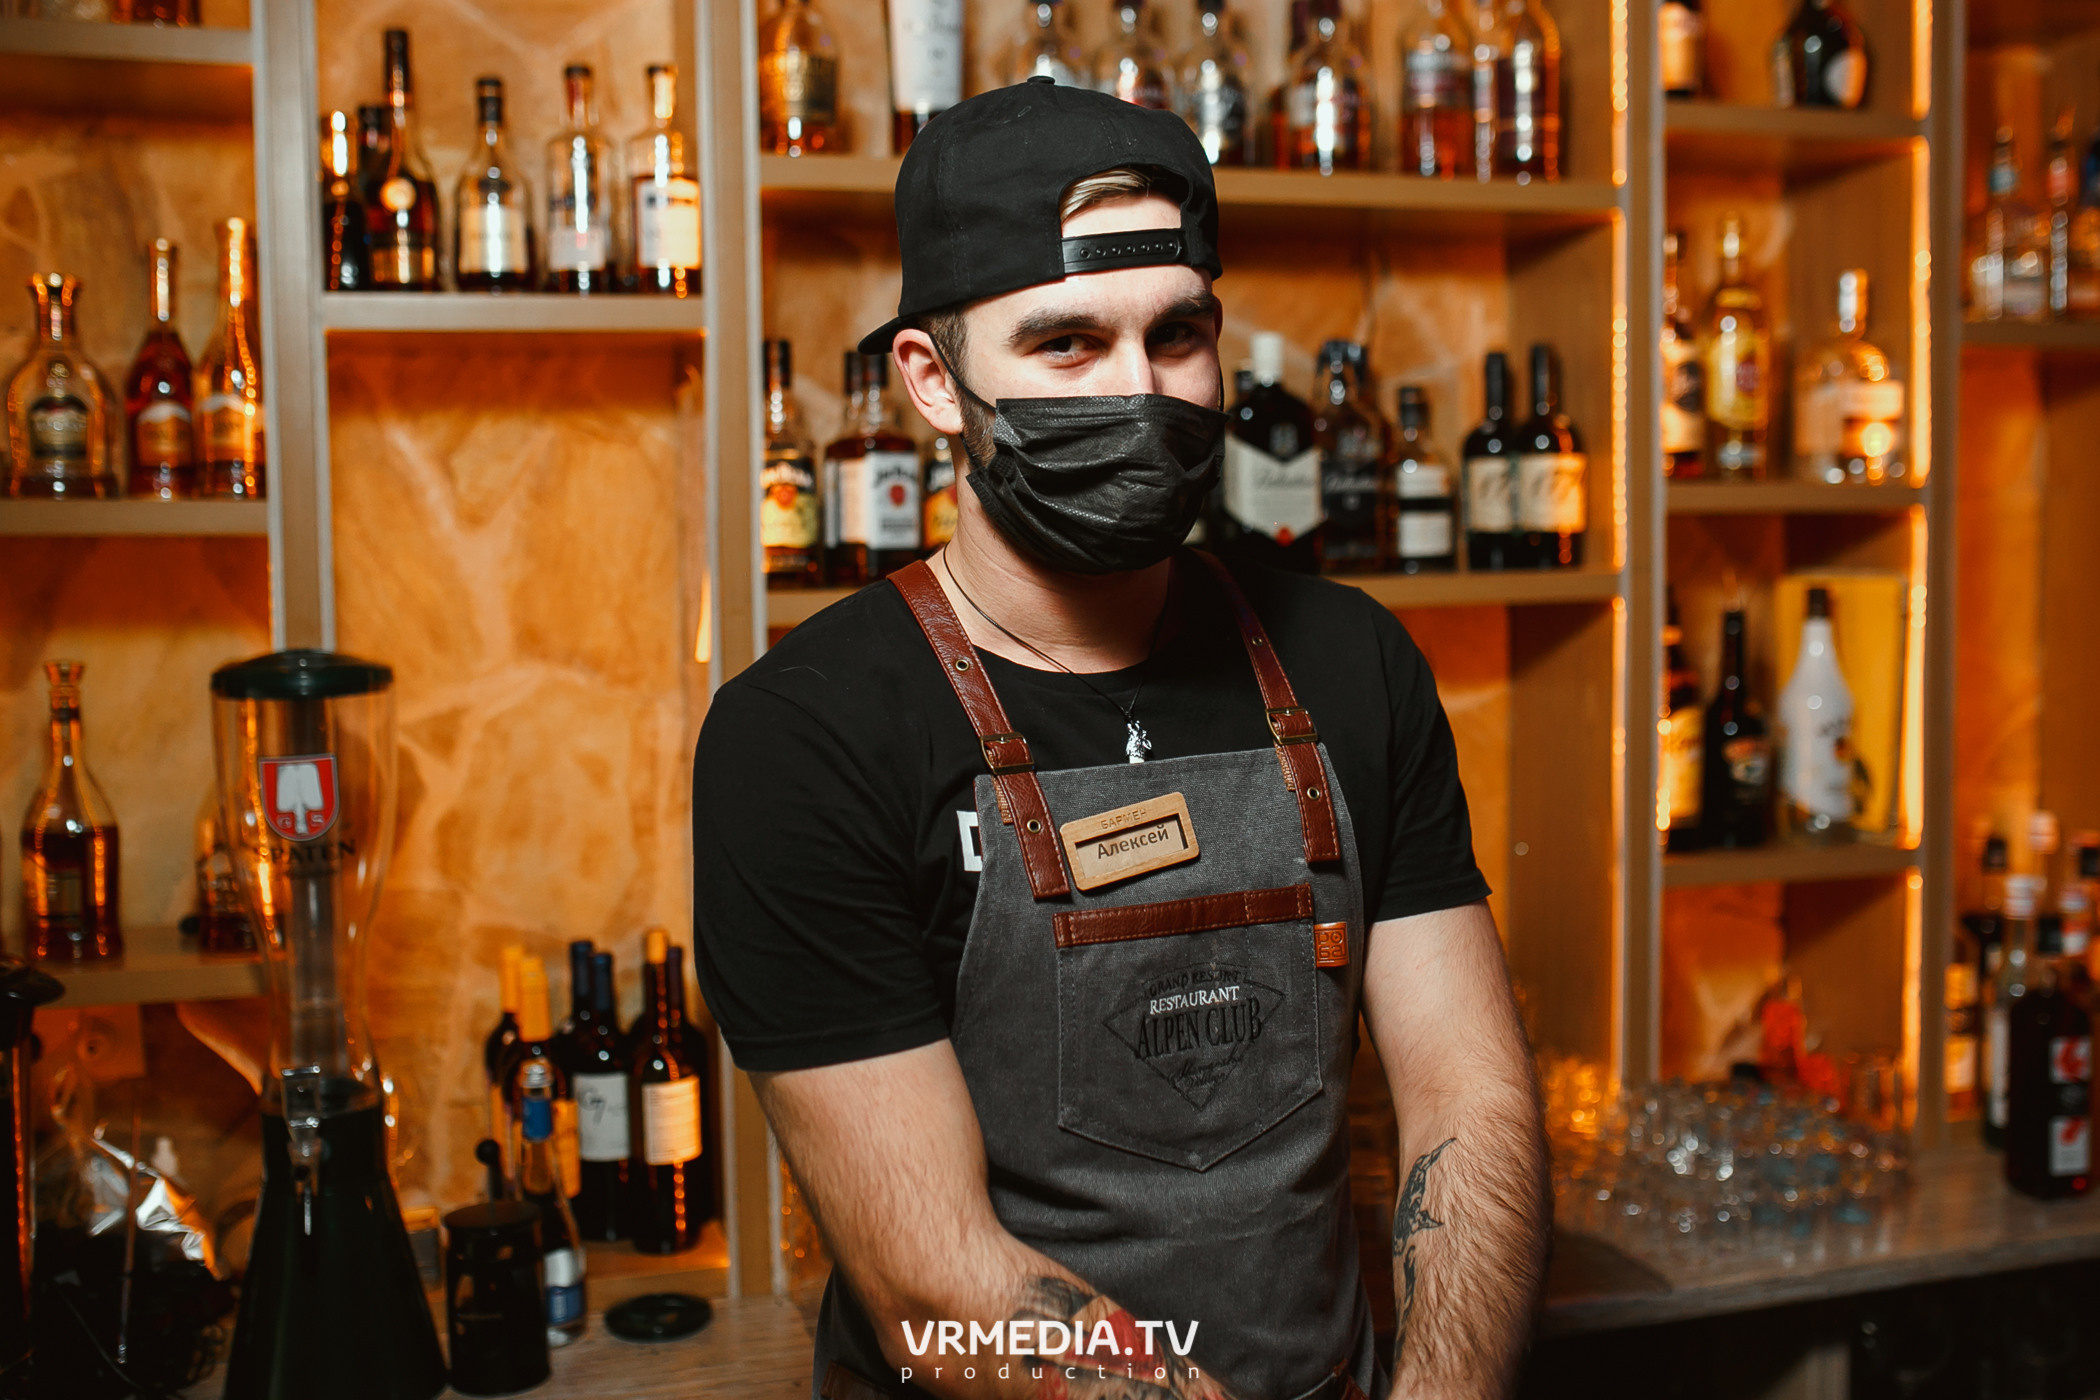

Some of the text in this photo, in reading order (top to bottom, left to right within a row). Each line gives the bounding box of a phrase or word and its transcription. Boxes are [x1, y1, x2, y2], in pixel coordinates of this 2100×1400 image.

[1097, 824, 1169, 860] Алексей
[1149, 985, 1240, 1015] RESTAURANT
[1136, 996, 1263, 1059] ALPEN CLUB
